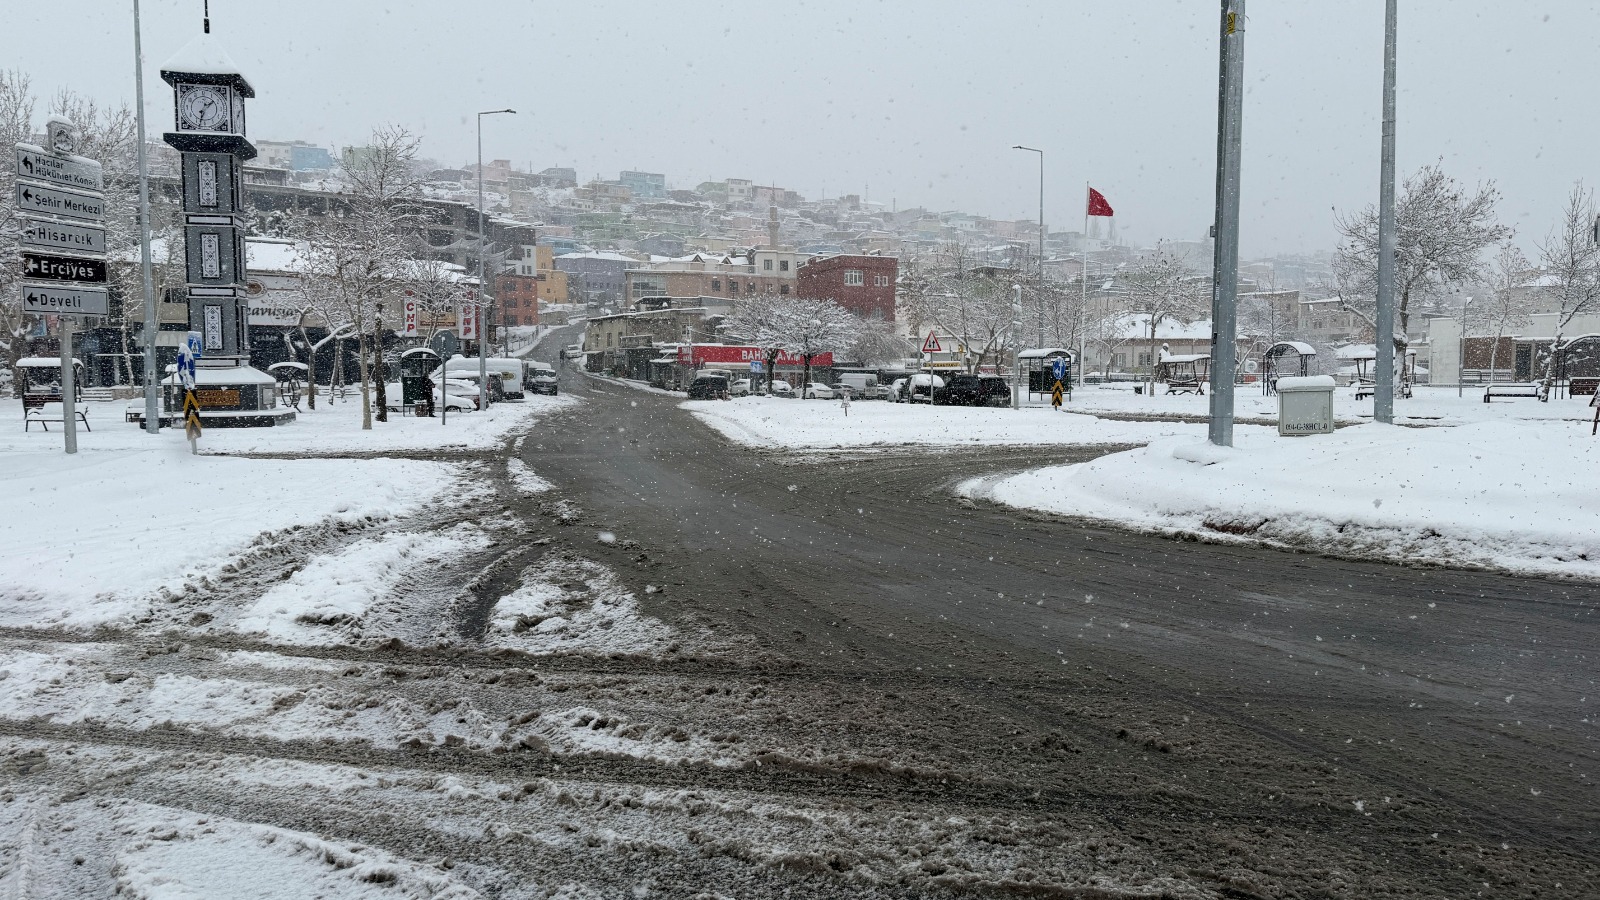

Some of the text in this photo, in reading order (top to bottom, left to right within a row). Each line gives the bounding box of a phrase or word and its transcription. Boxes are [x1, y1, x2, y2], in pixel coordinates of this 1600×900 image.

[35, 166, 98, 189] Hükümet Kona
[35, 193, 101, 215] Şehir Merkezi
[40, 260, 94, 279] Erciyes
[40, 293, 81, 309] Develi
